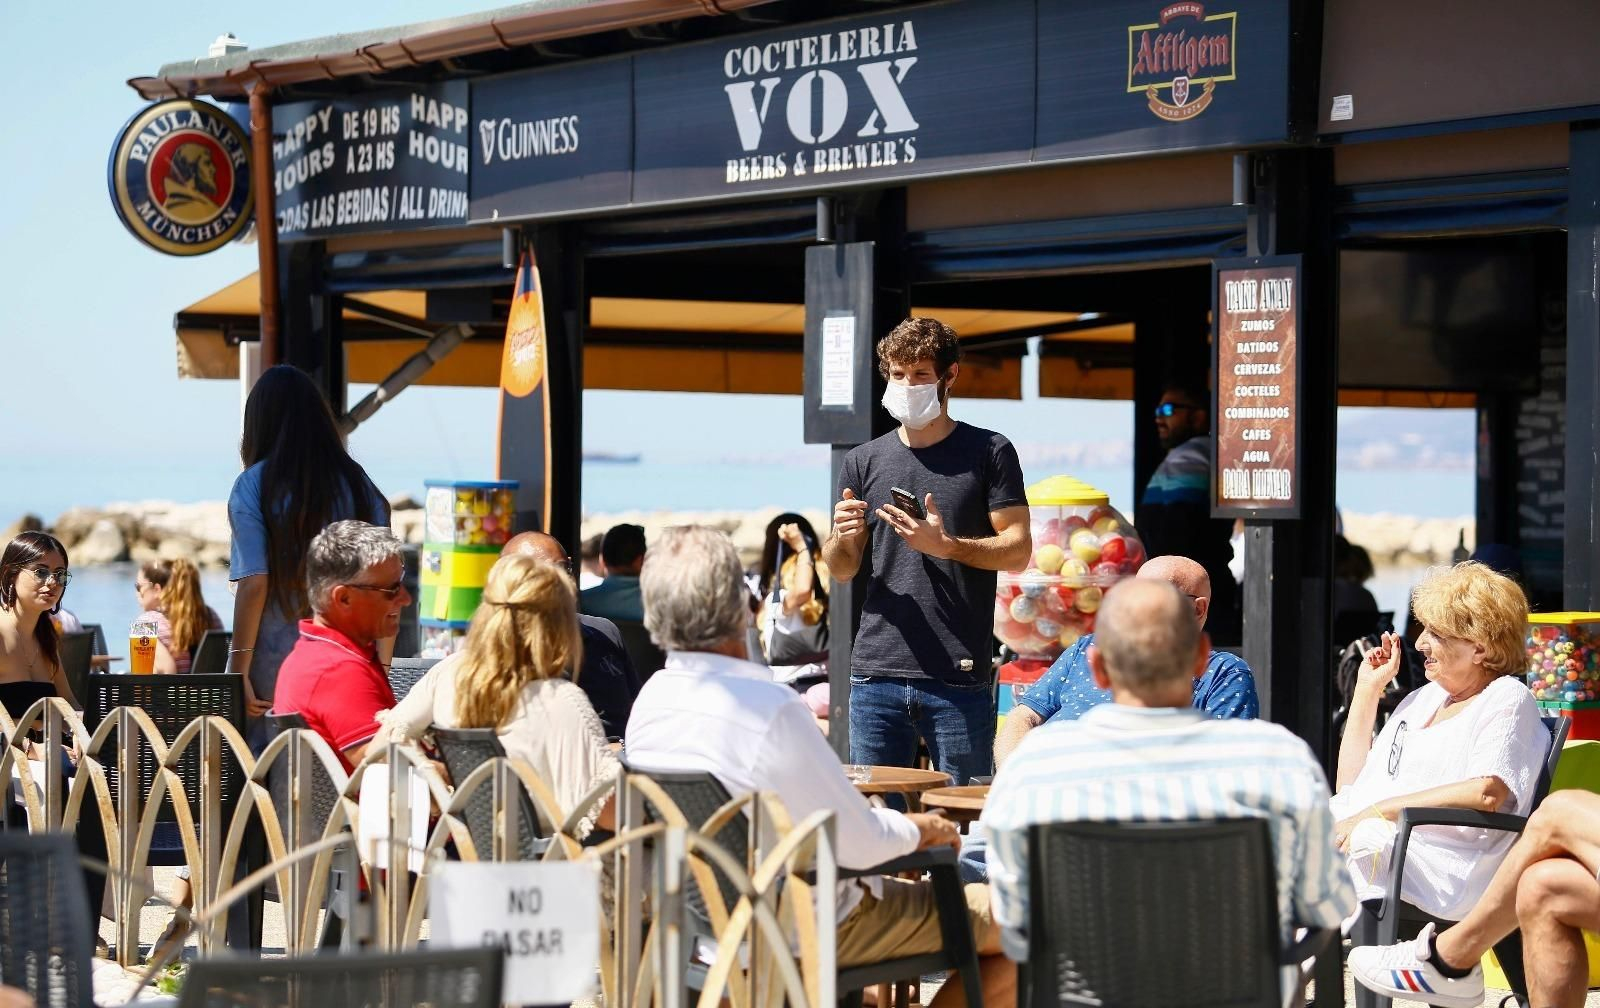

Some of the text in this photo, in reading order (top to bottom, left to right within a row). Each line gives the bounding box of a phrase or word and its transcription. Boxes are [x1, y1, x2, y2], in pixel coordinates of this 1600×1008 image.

[724, 21, 918, 78] COCTELERIA
[1133, 30, 1229, 78] Affligem
[411, 93, 468, 134] HAPP
[724, 57, 920, 151] VOX
[130, 110, 247, 168] PAULANER
[343, 105, 400, 140] DE 19 HS
[498, 115, 579, 161] GUINNESS
[346, 141, 395, 174] A 23 HS
[409, 130, 468, 174] HOUR
[726, 137, 917, 183] BEERS & BREWER'S
[137, 200, 237, 242] MÜNCHEN
[278, 202, 309, 234] ODAS
[311, 194, 335, 228] LAS
[337, 186, 389, 225] BEBIDAS
[399, 186, 424, 219] ALL
[1260, 278, 1292, 312] AWAY
[1240, 320, 1275, 332] ZUMOS
[1237, 342, 1279, 354] BATIDOS
[1234, 364, 1281, 375] CERVEZAS
[1234, 386, 1281, 397] COCTELES
[1225, 407, 1290, 419] COMBINADOS
[1242, 429, 1272, 441] CAFES
[1242, 451, 1270, 463] AGUA
[507, 888, 543, 916] NO
